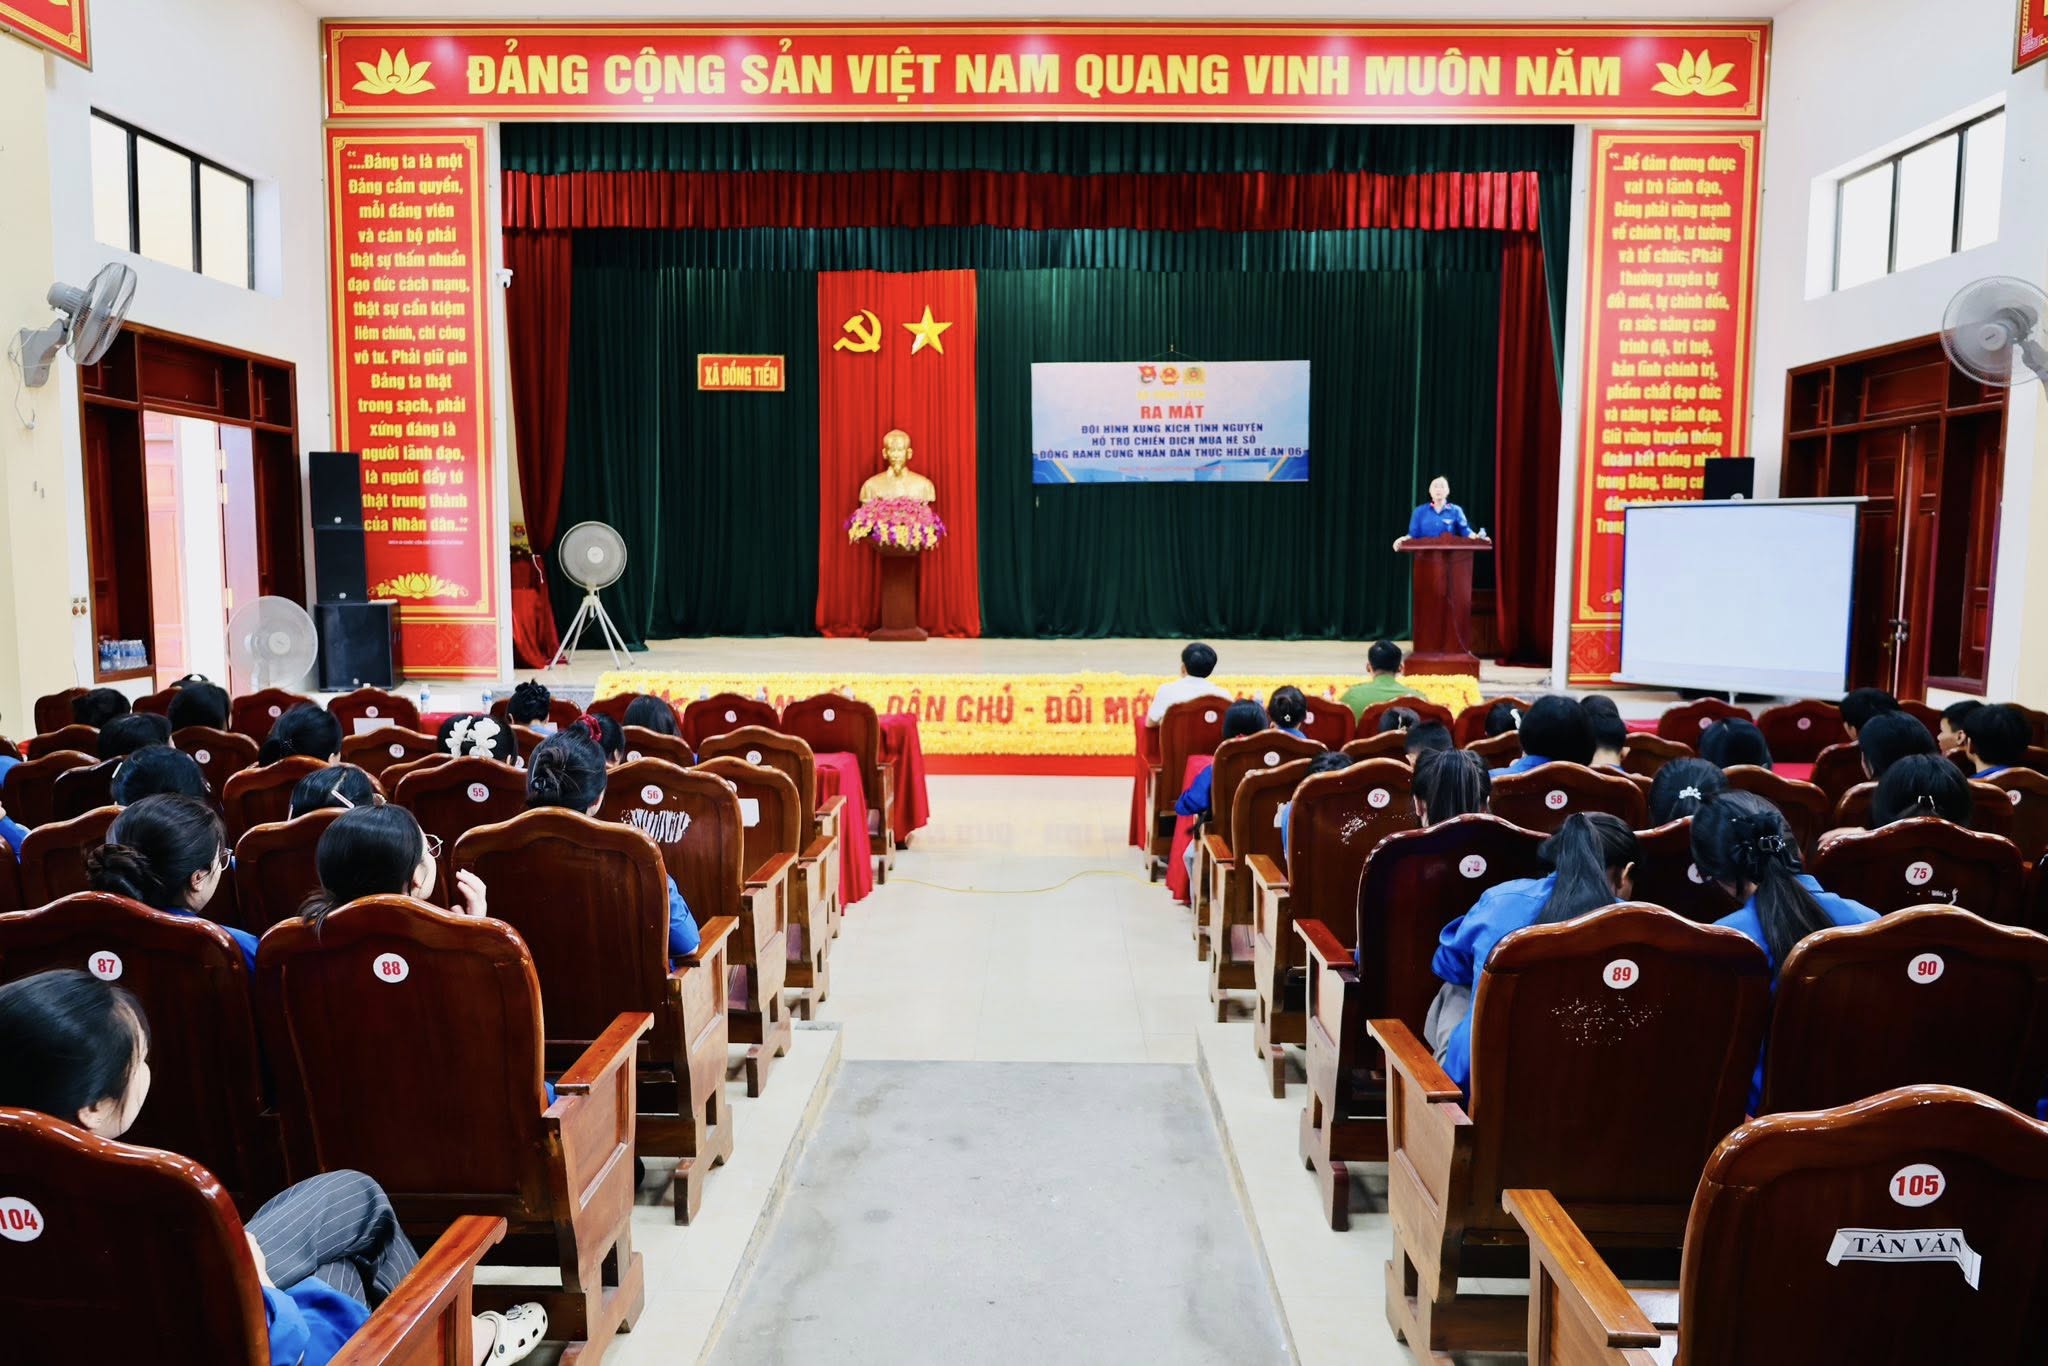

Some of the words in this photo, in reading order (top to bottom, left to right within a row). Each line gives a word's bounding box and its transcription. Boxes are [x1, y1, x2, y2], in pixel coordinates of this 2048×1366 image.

[467, 39, 588, 94] ĐẢNG
[604, 47, 725, 103] CỘNG
[740, 39, 831, 94] SẢN
[848, 47, 940, 102] VIỆT
[956, 54, 1059, 93] NAM
[1076, 54, 1228, 98] QUANG
[1245, 55, 1349, 96] VINH
[1366, 48, 1500, 96] MUÔN
[1516, 48, 1620, 96] NĂM
[1140, 405, 1162, 419] RA
[1133, 424, 1161, 433] XUNG
[886, 688, 946, 723] DÂN
[957, 684, 1014, 724] CHỦ
[1045, 684, 1092, 724] ĐỔI
[1104, 688, 1153, 724] MỚ
[471, 787, 486, 797] 55
[646, 789, 659, 800] 56
[1372, 793, 1386, 803] 57
[1550, 794, 1563, 804] 58
[1912, 867, 1928, 880] 75
[97, 959, 116, 974] 87
[382, 961, 402, 976] 88
[1611, 966, 1632, 982] 89
[1917, 960, 1938, 977] 90
[1896, 1174, 1940, 1197] 105
[0, 1208, 38, 1231] 104
[1852, 1233, 1907, 1254] TÂN
[1914, 1232, 1962, 1253] VĂN
